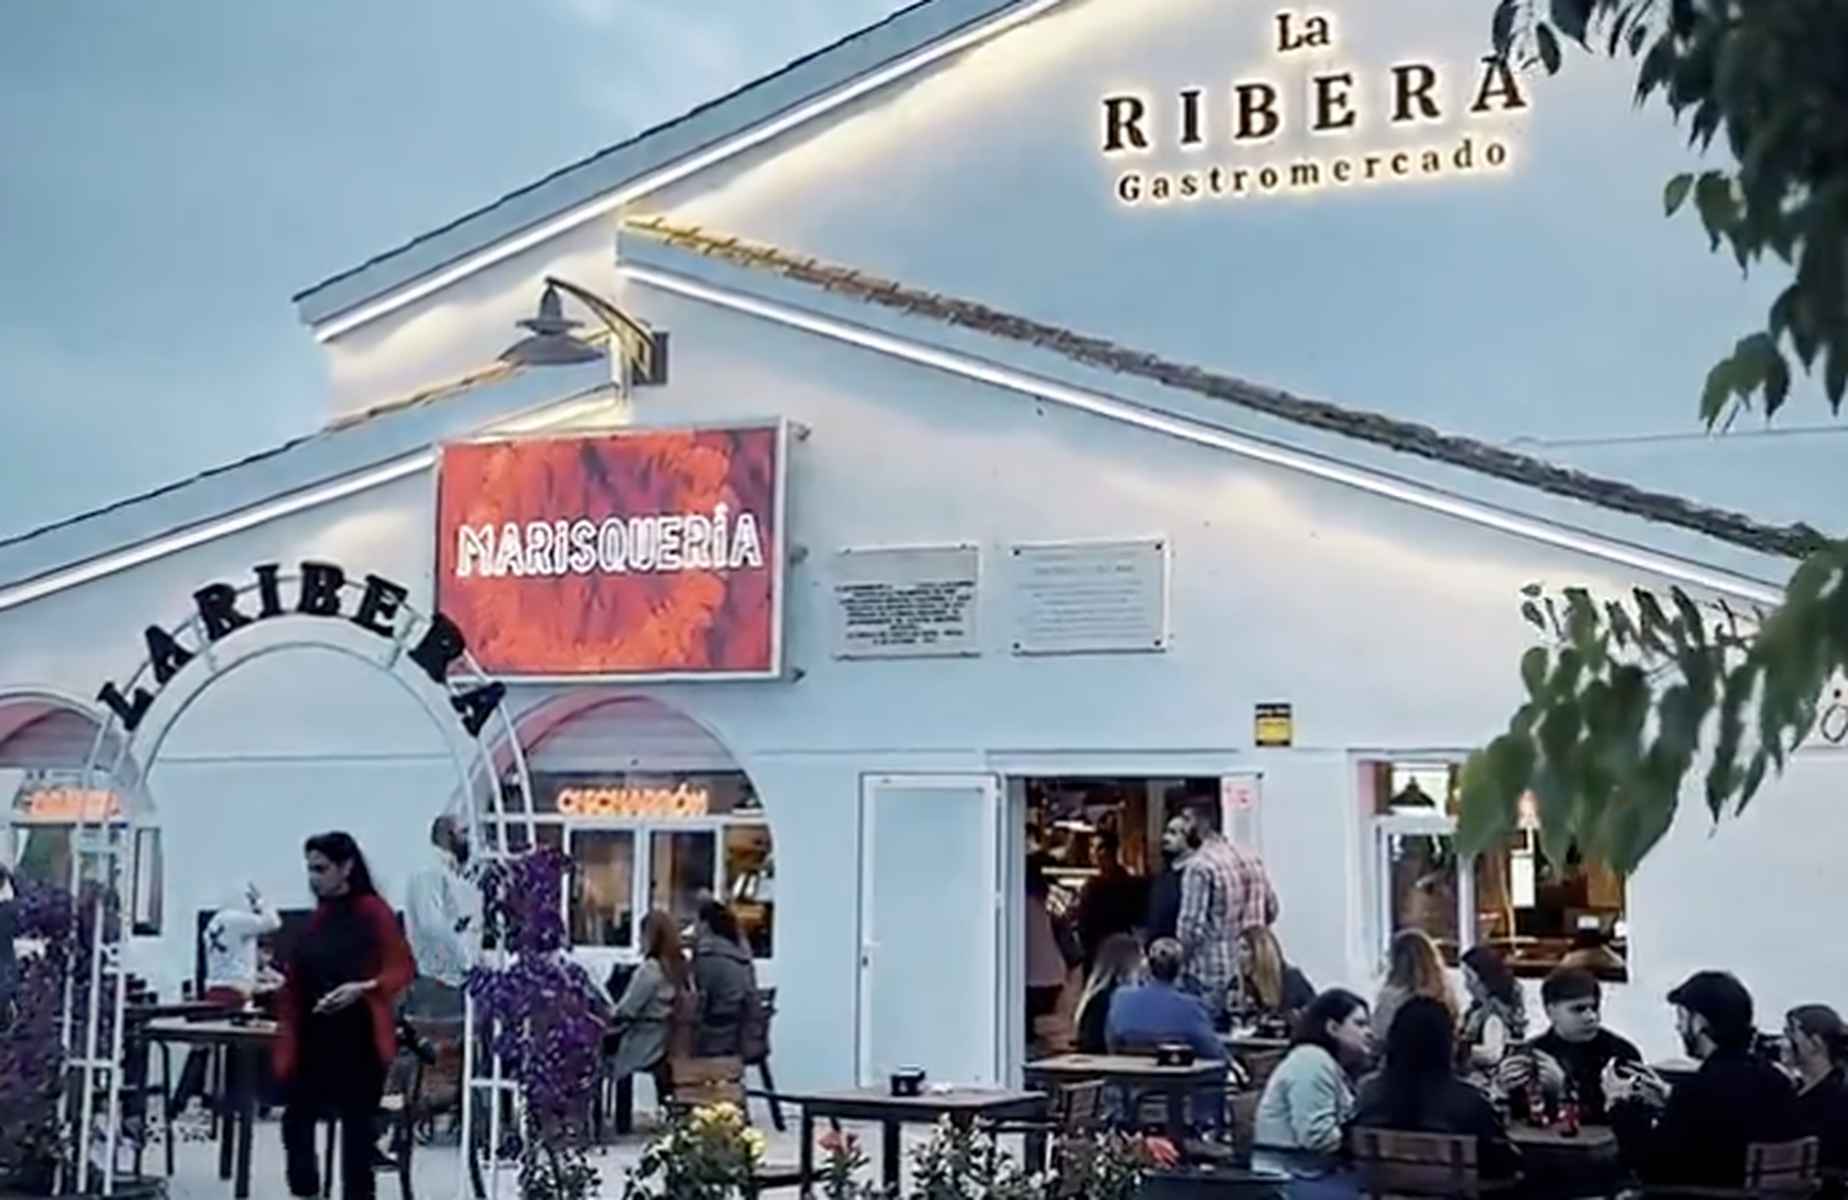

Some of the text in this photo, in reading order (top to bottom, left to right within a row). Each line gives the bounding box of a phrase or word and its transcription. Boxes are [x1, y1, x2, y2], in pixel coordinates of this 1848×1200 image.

[1276, 13, 1330, 52] La
[1102, 55, 1527, 153] RIBERA
[1118, 138, 1508, 201] Gastromercado
